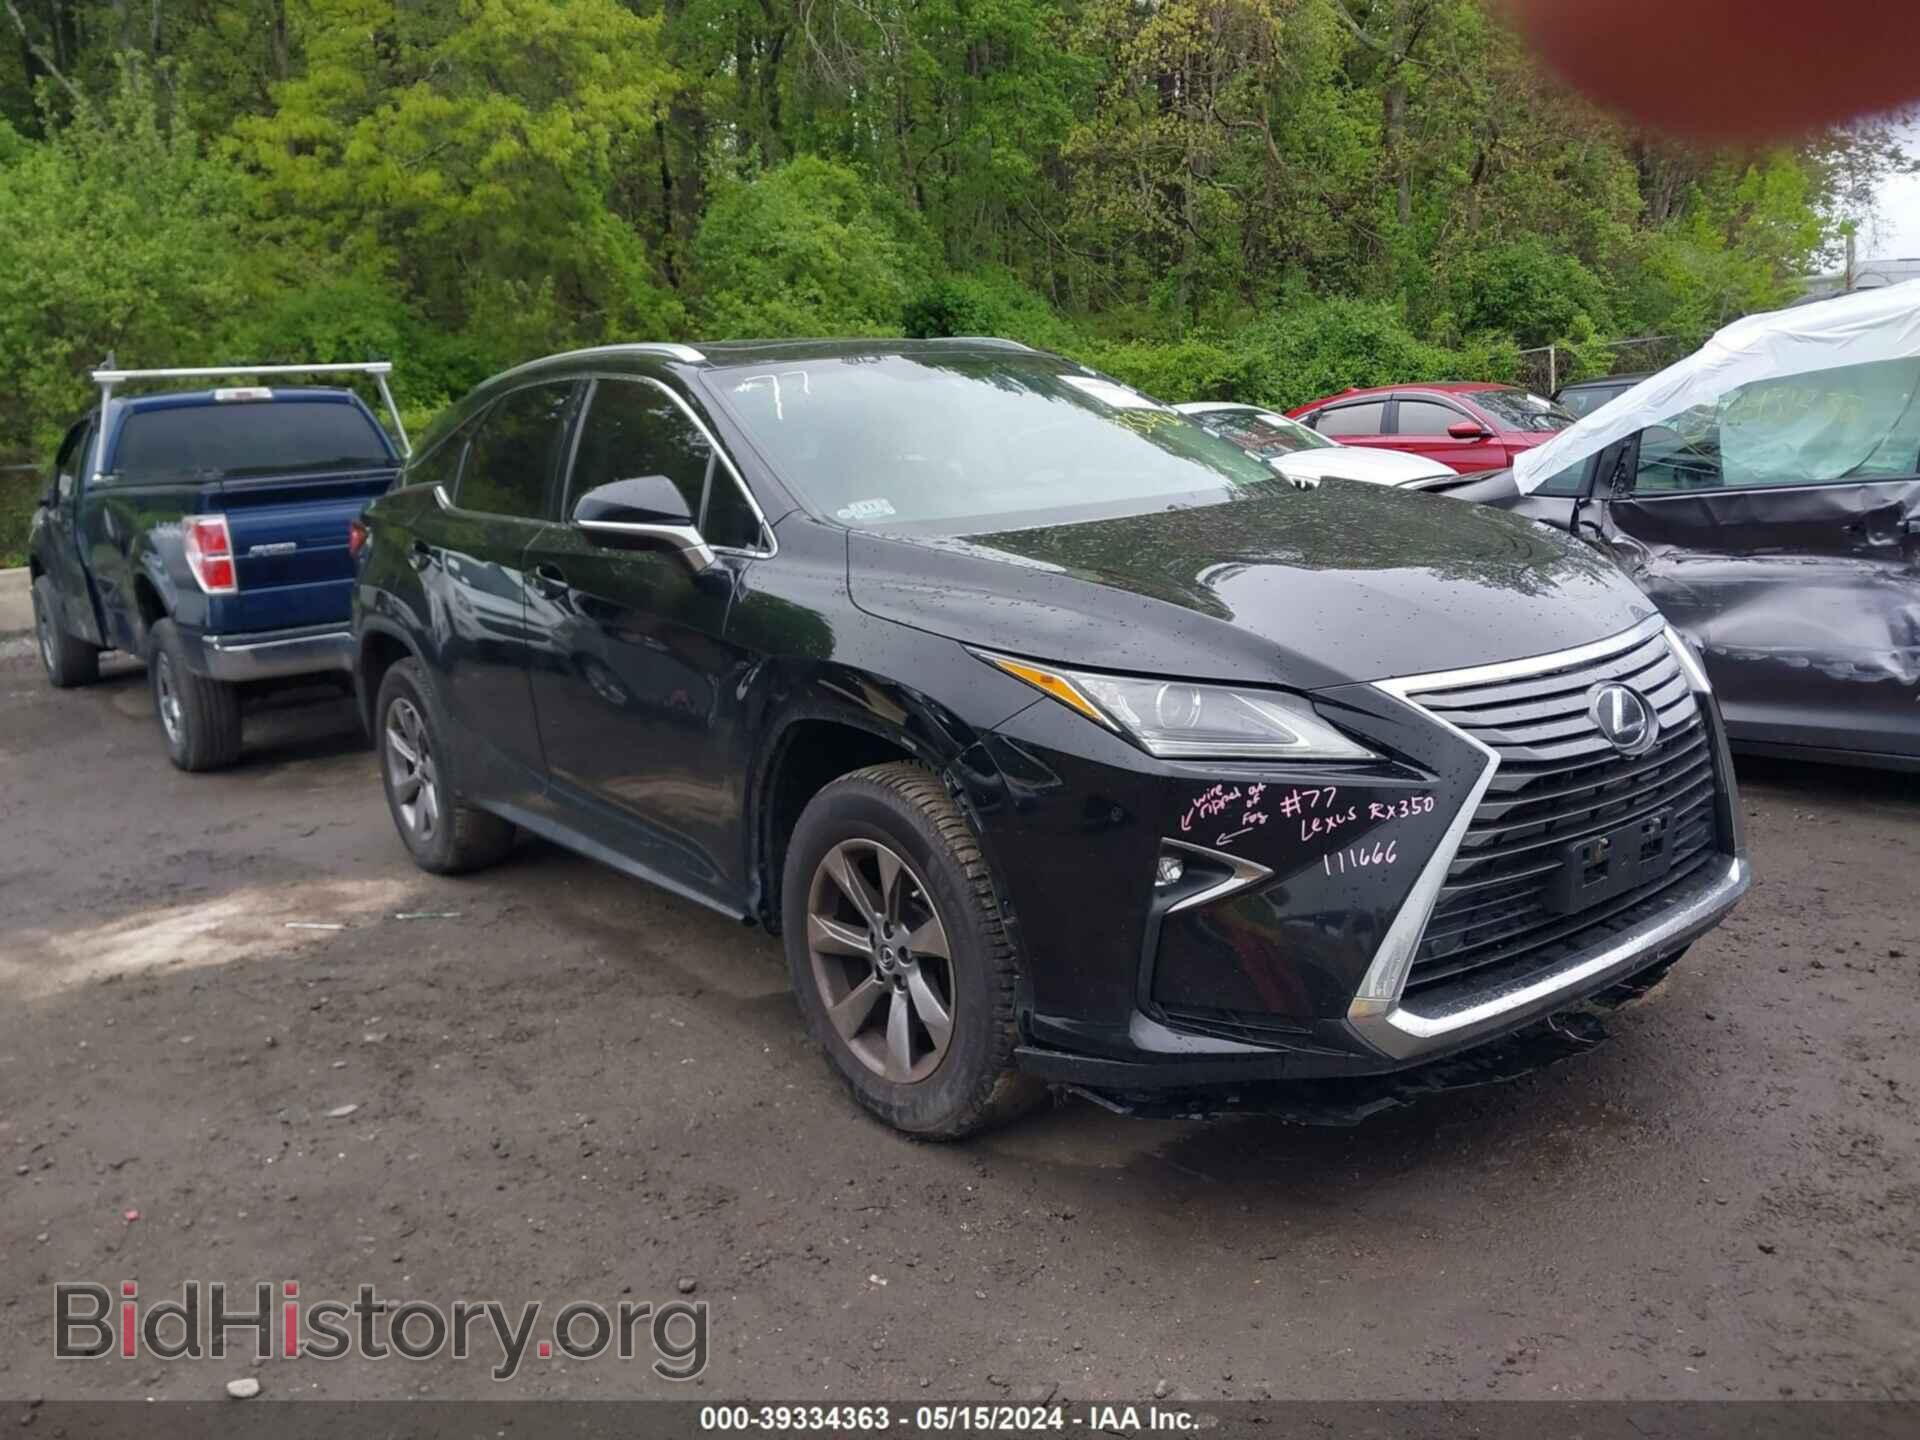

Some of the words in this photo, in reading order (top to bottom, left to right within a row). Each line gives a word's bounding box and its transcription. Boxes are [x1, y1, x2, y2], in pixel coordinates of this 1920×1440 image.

[1193, 783, 1223, 807] wire
[1280, 786, 1337, 818] #77
[1301, 806, 1357, 841] Lexus
